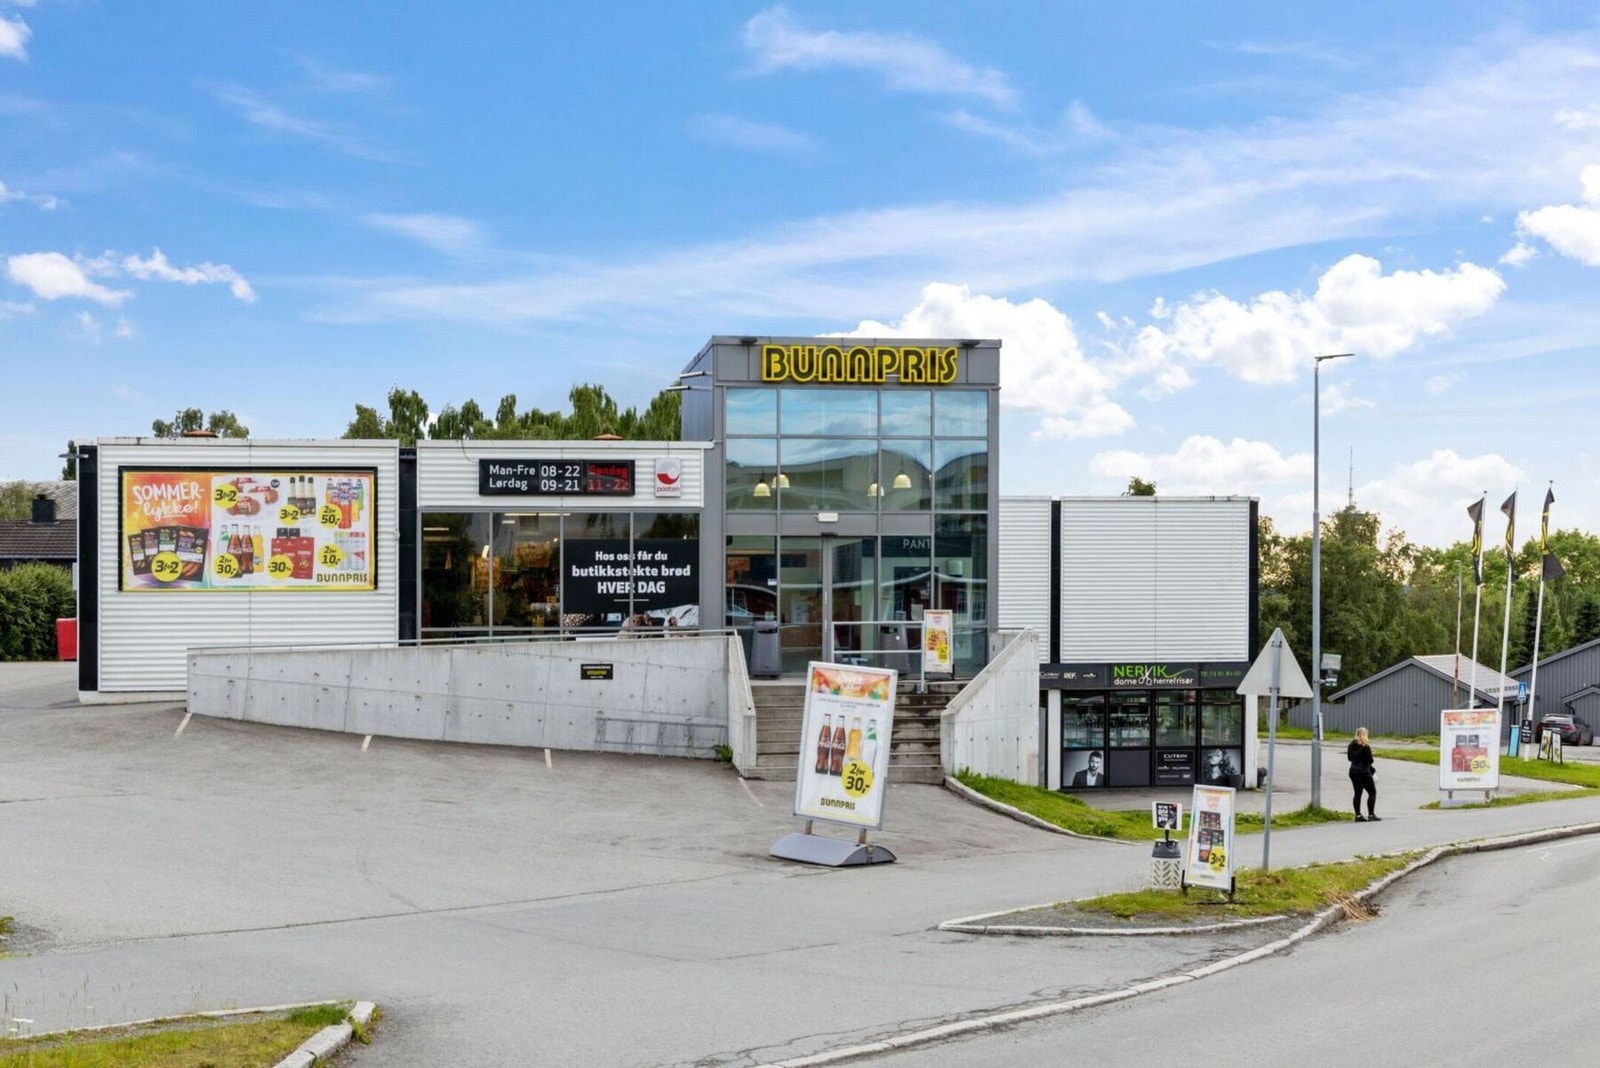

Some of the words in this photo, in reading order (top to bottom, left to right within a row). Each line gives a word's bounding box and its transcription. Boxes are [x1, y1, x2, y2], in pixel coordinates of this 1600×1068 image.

[761, 345, 958, 383] BUNNPRIS
[489, 465, 536, 475] Man-Fre
[489, 479, 527, 490] Lørdag
[595, 551, 614, 561] Hos
[637, 550, 652, 561] får
[654, 551, 668, 561] du
[661, 565, 691, 576] brød
[316, 573, 367, 583] BUNNPRIS
[597, 582, 636, 594] HVER
[637, 581, 666, 594] DAG
[1114, 664, 1167, 677] NERVIK
[1114, 678, 1137, 686] dame
